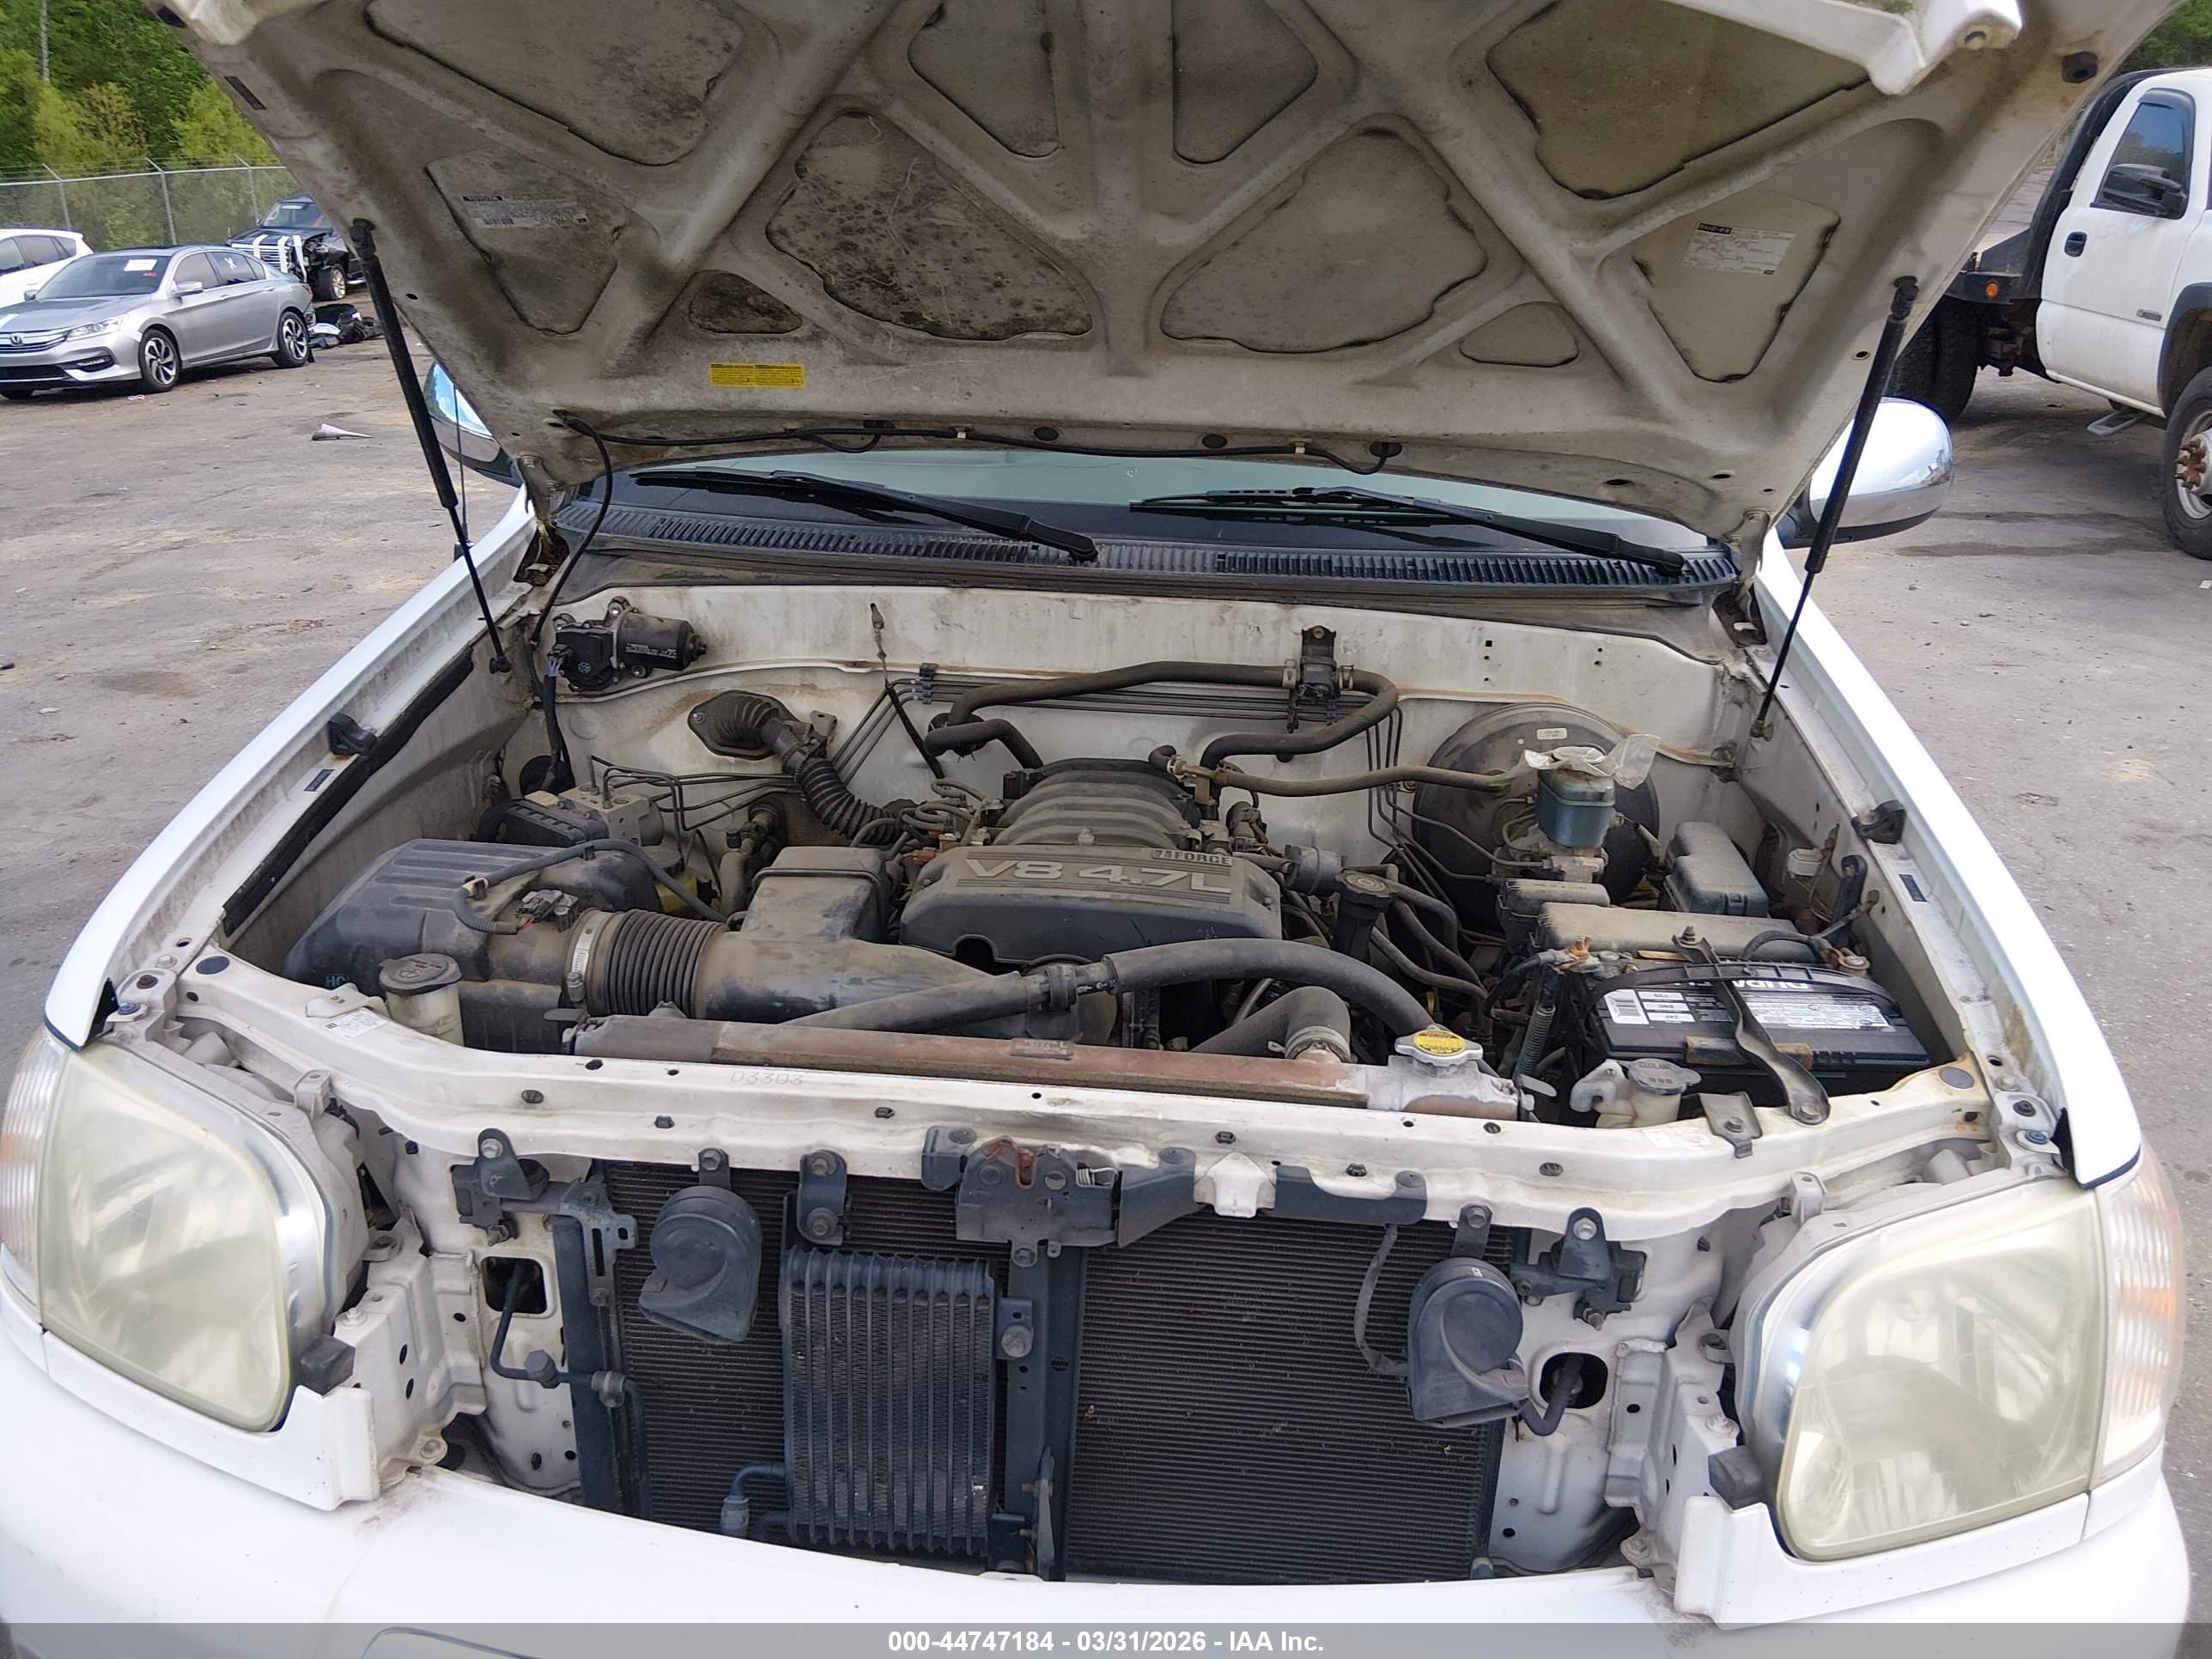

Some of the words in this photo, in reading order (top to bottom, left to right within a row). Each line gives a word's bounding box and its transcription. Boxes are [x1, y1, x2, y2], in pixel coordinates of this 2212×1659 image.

[964, 859, 1064, 879] V8
[1078, 865, 1232, 894] 4.7L
[730, 1070, 805, 1086] 03303
